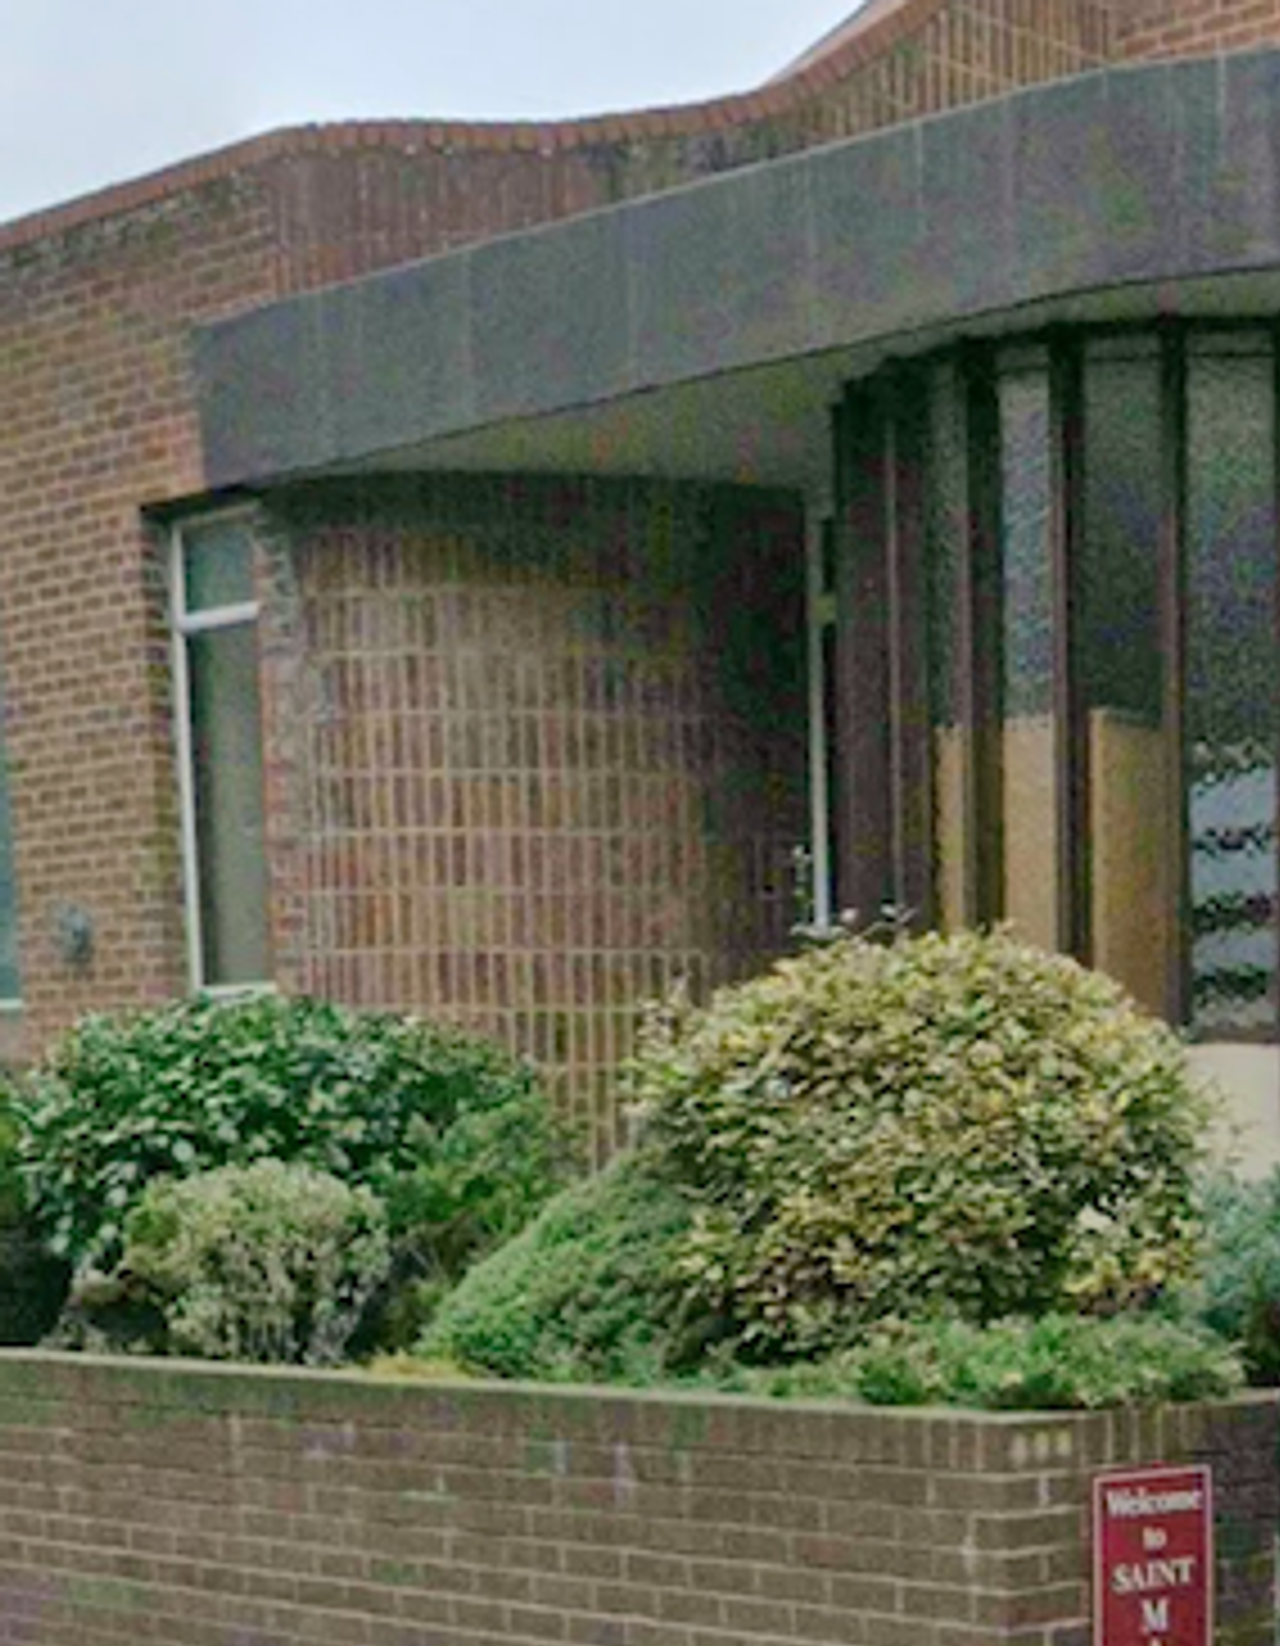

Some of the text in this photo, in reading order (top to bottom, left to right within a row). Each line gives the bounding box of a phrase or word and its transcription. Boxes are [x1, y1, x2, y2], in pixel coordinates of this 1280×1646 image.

[1107, 1488, 1202, 1517] Welcome
[1142, 1526, 1167, 1550] to
[1111, 1557, 1194, 1593] SAINT
